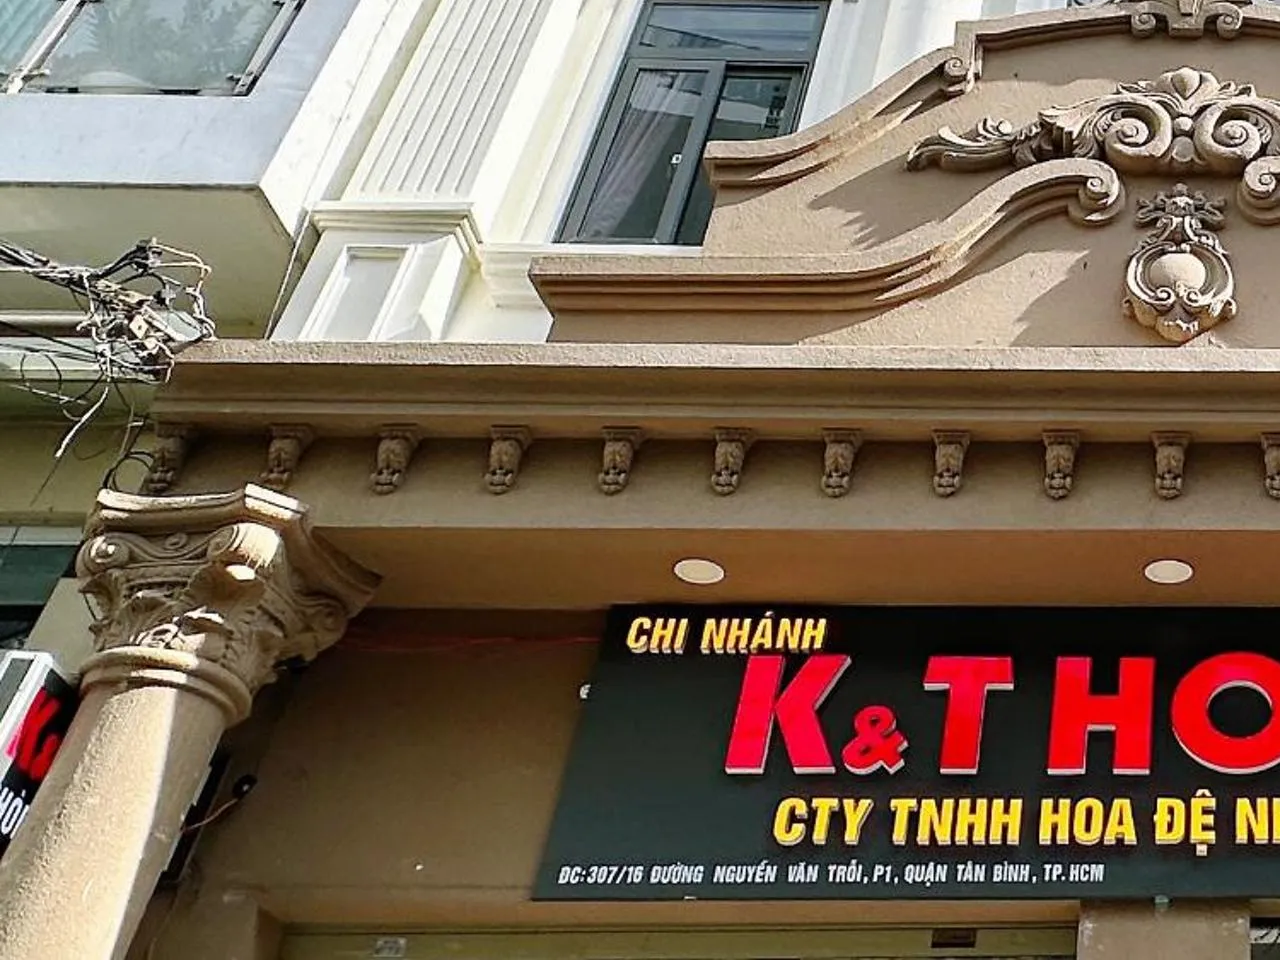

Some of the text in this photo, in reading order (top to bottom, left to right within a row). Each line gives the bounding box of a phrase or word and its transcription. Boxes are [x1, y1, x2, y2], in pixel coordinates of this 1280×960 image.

[626, 611, 827, 654] CHI NHÁNH
[773, 797, 875, 846] CTY
[890, 797, 1019, 846] TNHH
[1038, 797, 1137, 846] HOA
[1154, 788, 1216, 856] ĐỆ
[788, 862, 819, 883] VĂN
[904, 862, 948, 887] QUẬN
[957, 861, 985, 883] TÂN
